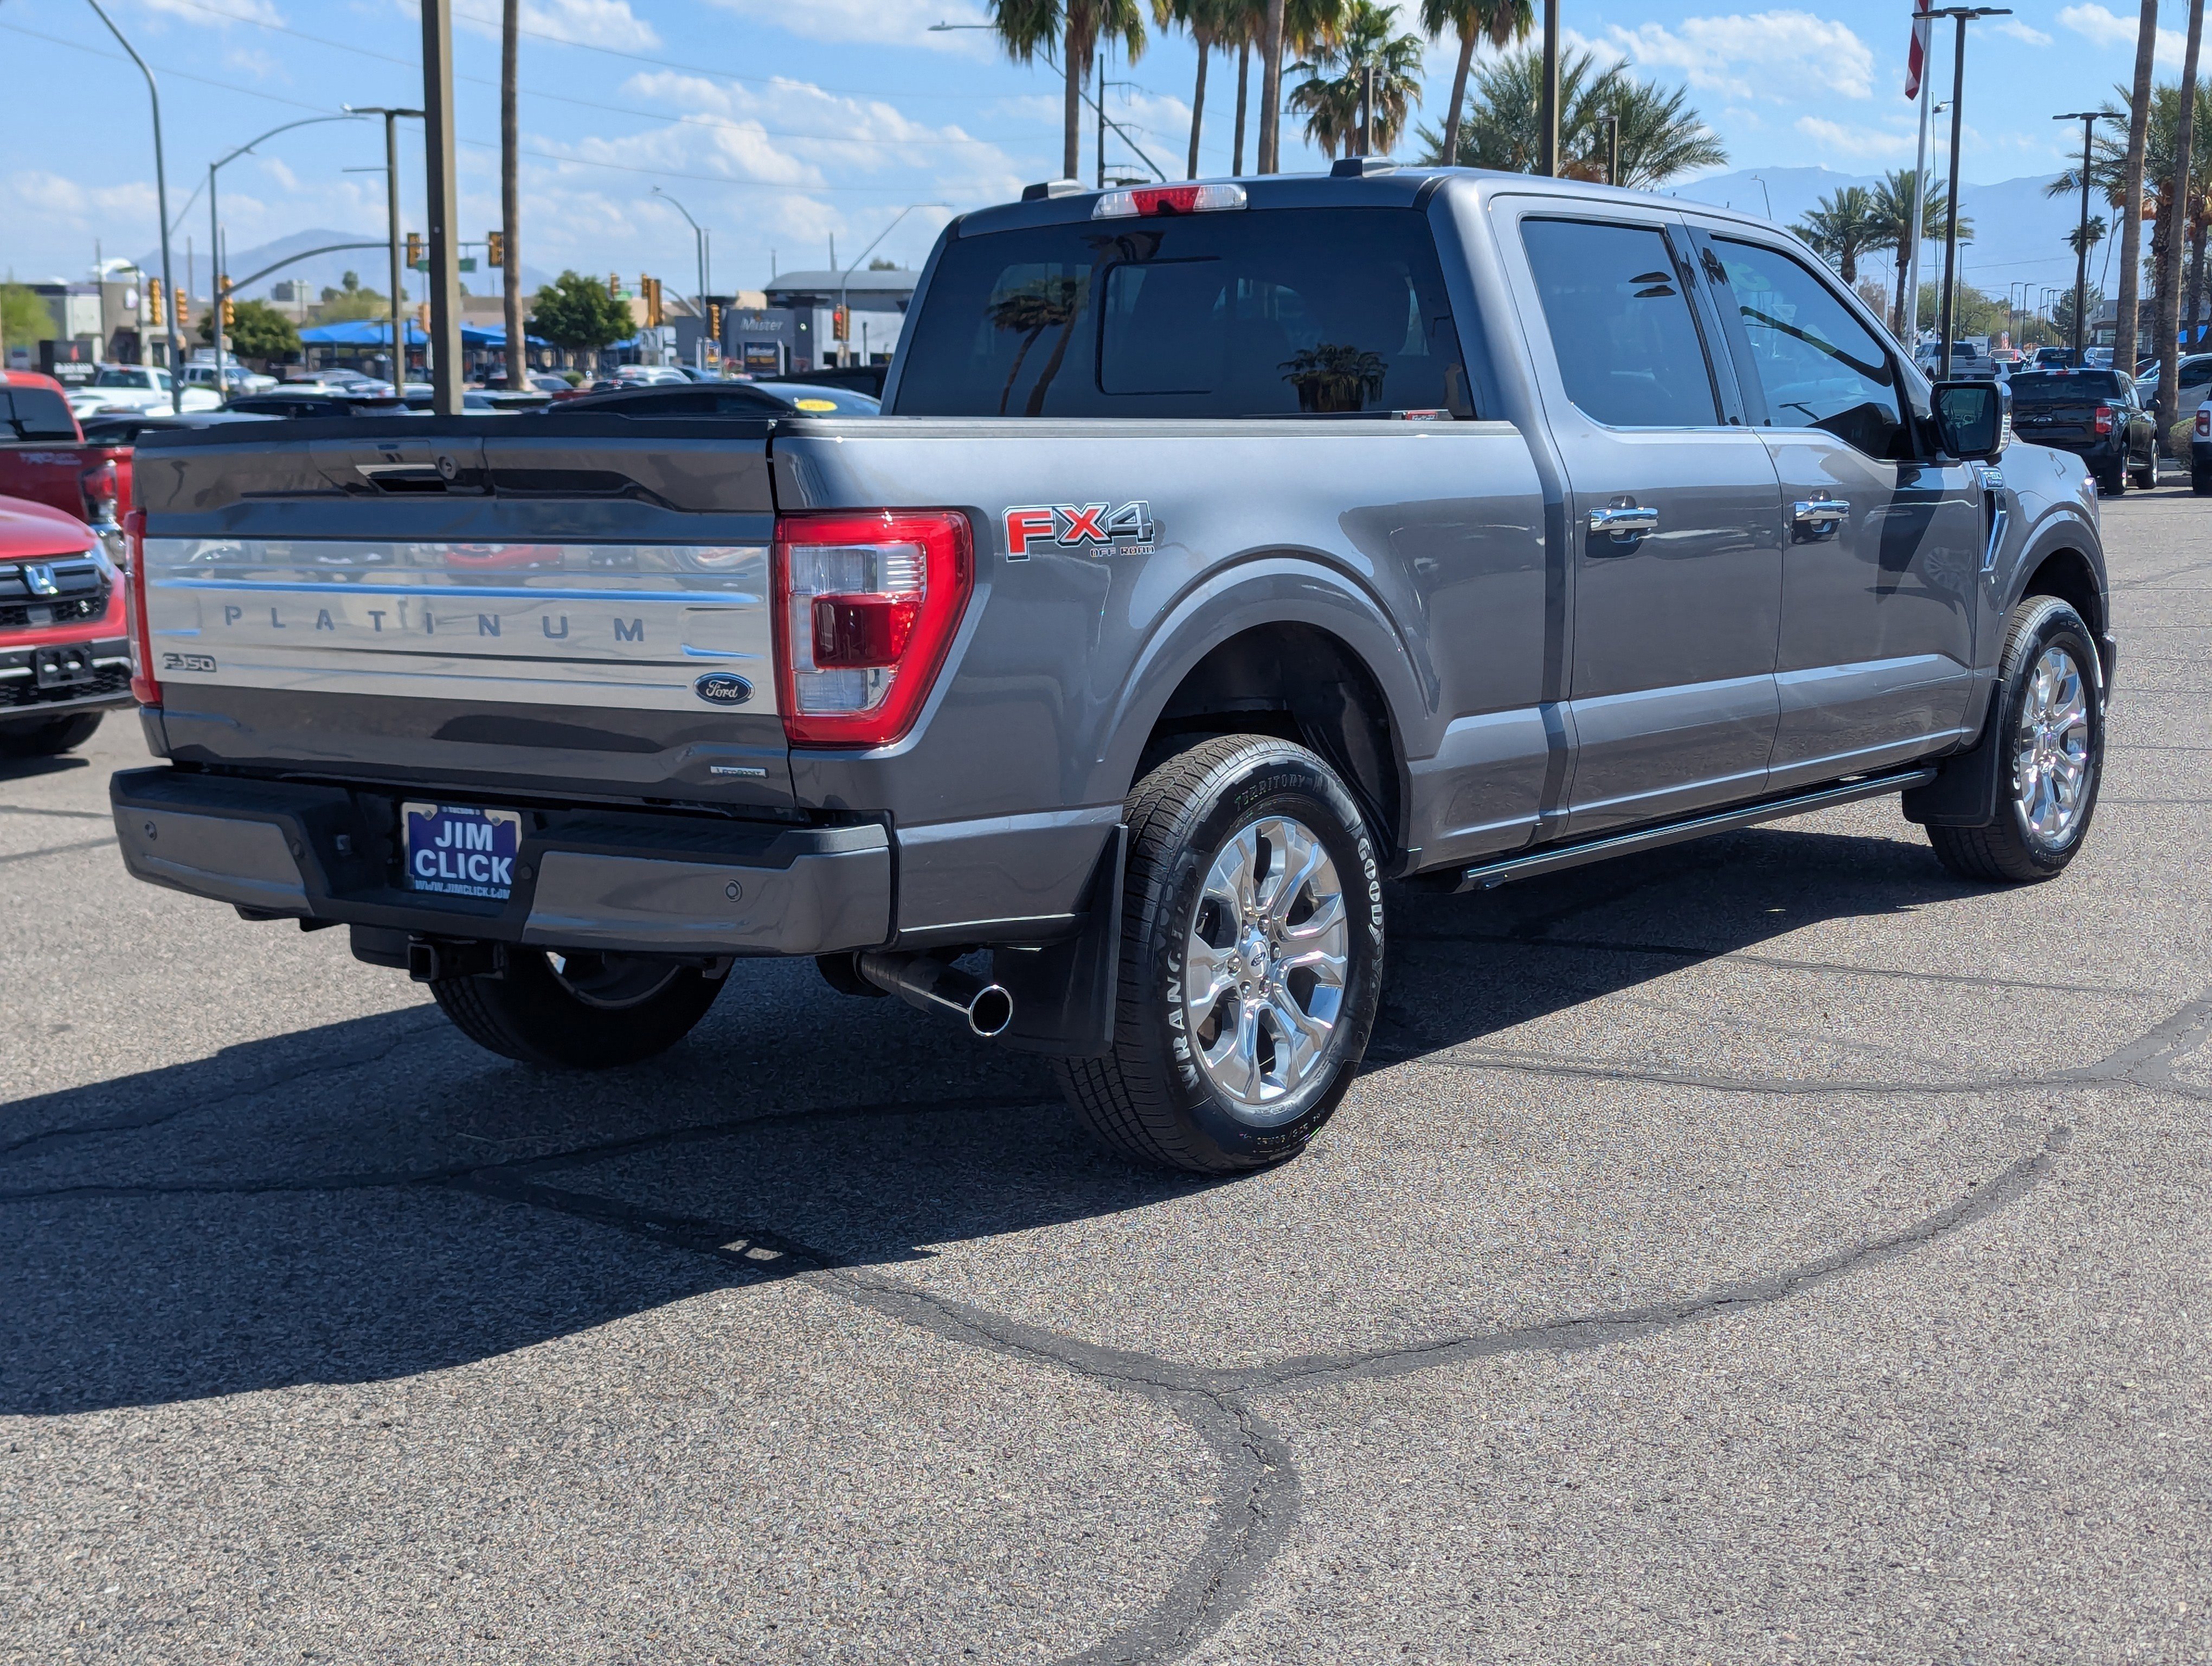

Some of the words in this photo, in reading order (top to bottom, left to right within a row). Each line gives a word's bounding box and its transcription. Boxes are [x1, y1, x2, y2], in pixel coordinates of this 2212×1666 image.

[1002, 500, 1155, 562] FX4
[1090, 547, 1116, 558] OFF
[1120, 544, 1156, 556] ROAD
[224, 605, 644, 642] PLATINUM
[163, 652, 217, 672] F-150
[705, 680, 738, 698] Ford
[435, 821, 493, 851] JIM
[415, 849, 512, 885] CLICK
[1358, 838, 1384, 1011] GOODY
